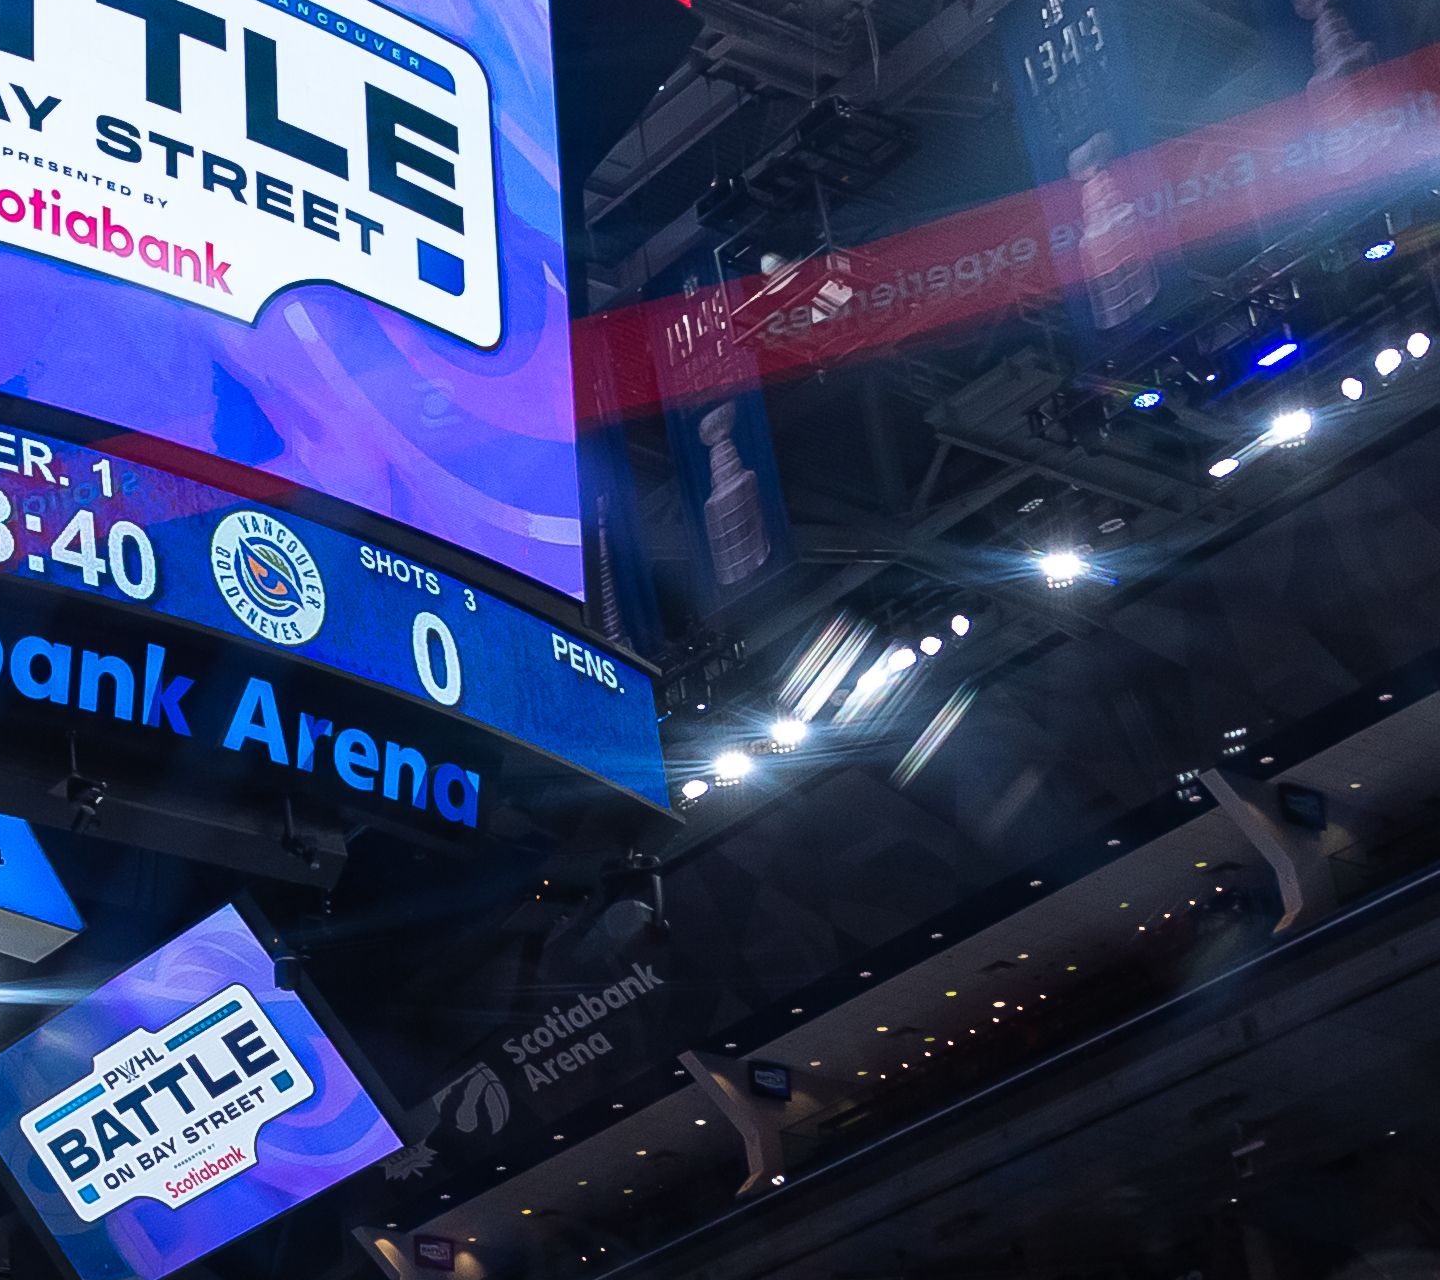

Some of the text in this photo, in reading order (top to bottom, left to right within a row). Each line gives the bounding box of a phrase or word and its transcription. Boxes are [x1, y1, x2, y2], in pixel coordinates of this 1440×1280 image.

[2, 146, 170, 211] PRESENTED BY
[95, 115, 385, 256] STREET
[92, 458, 113, 498] 1
[237, 514, 322, 610] VANCOUVER
[360, 545, 477, 612] SHOTS 3
[411, 611, 462, 707] 0
[551, 631, 626, 695] PENS.
[222, 675, 482, 830] Arena
[101, 1045, 165, 1091] PWHL
[501, 961, 665, 1093] Scotiabank Arena
[47, 1019, 281, 1182] BATTLE
[103, 1165, 136, 1191] ON
[136, 1142, 180, 1175] BAY
[181, 1086, 267, 1146] STREET
[164, 1145, 248, 1201] Scotiabank
